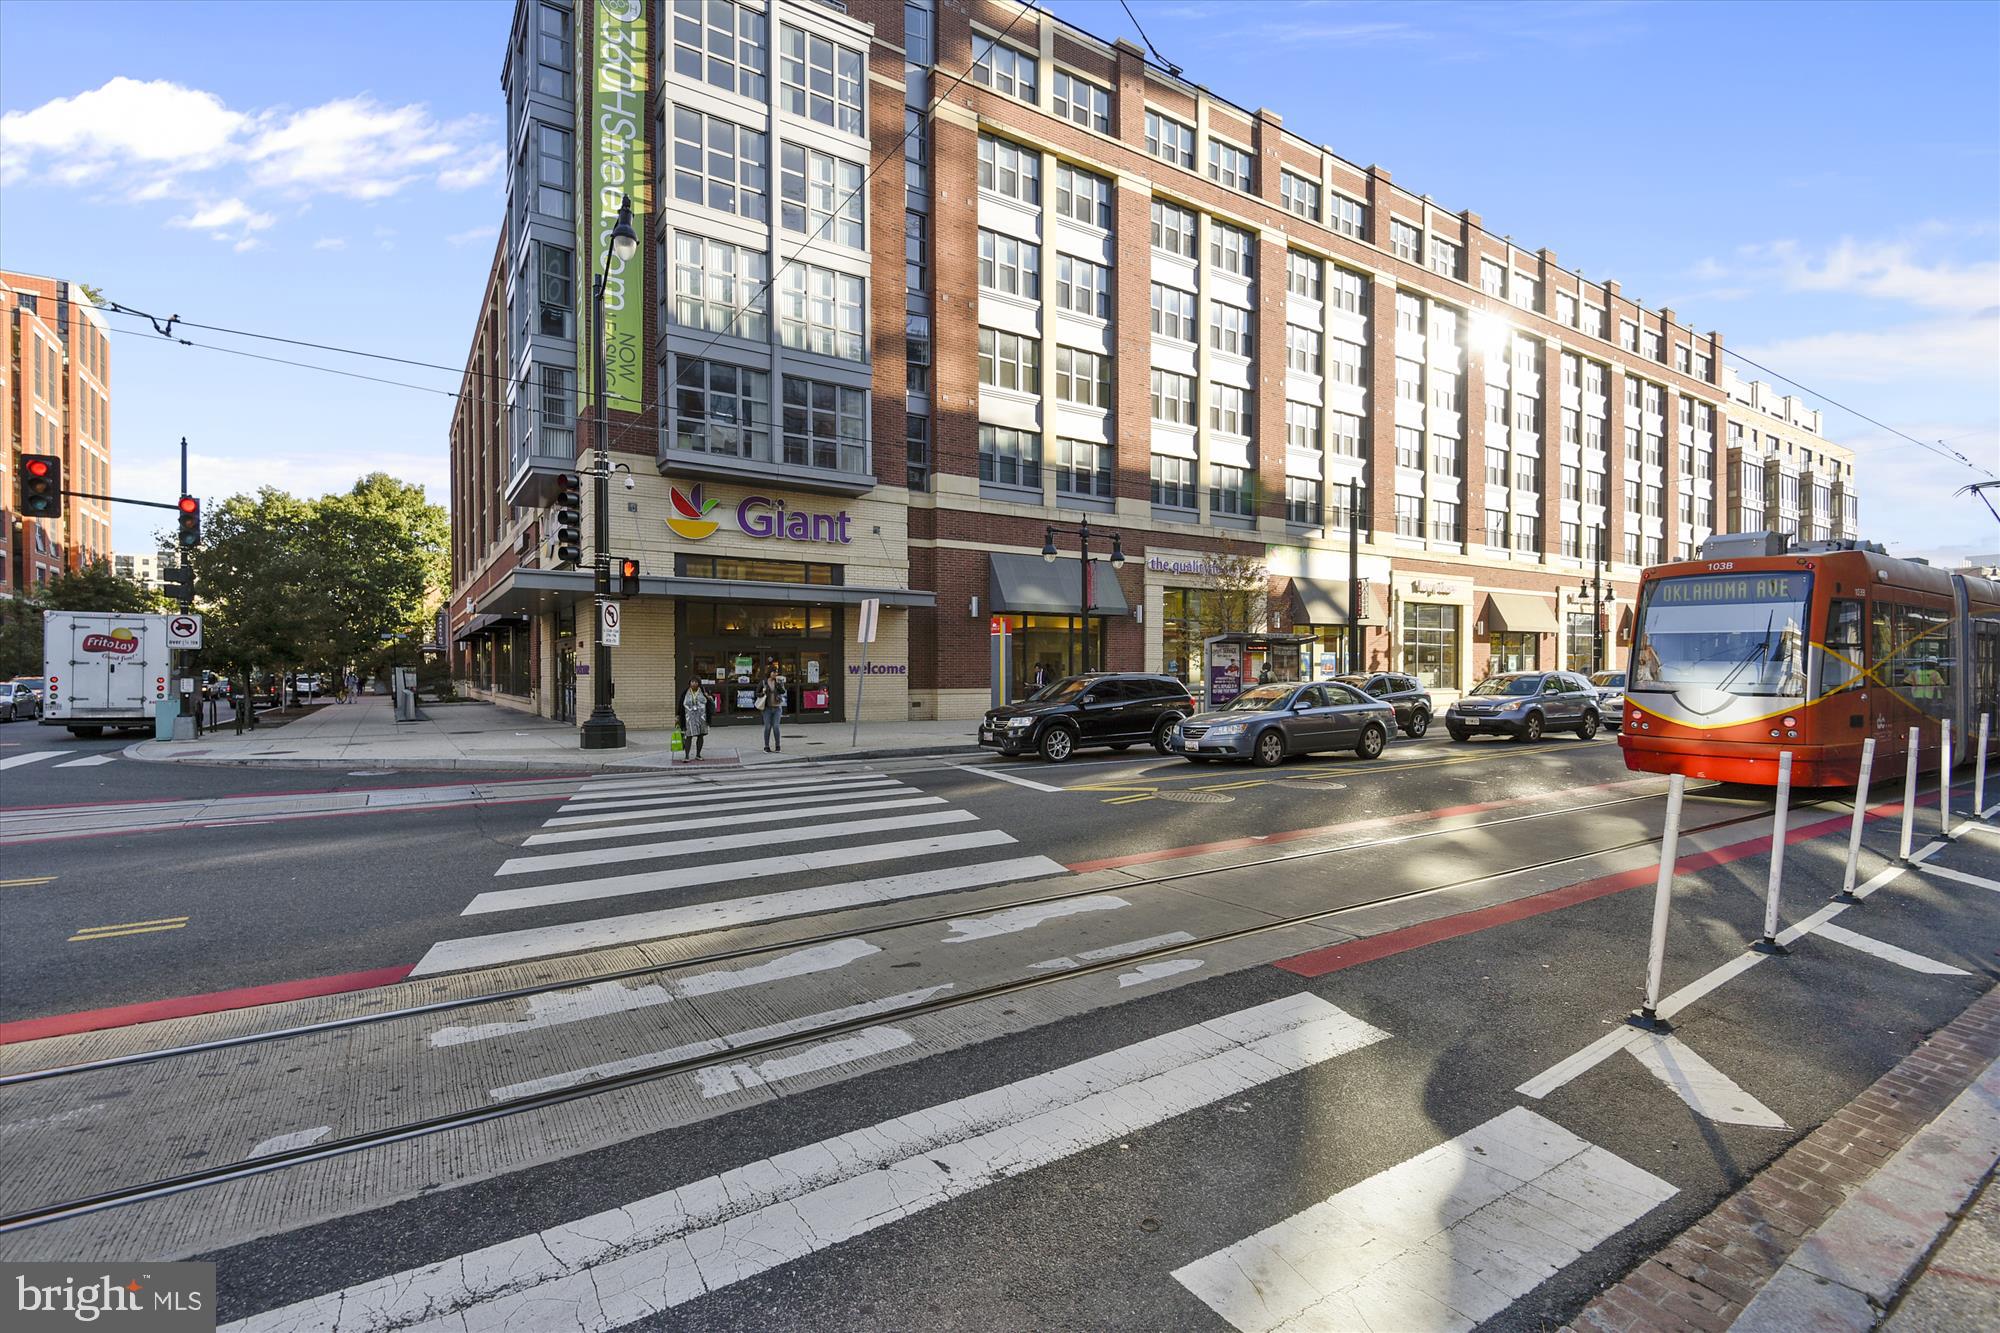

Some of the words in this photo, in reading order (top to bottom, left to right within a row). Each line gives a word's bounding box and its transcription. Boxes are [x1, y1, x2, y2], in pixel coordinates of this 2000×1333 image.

[618, 332, 636, 383] NOW
[736, 495, 852, 545] Giant
[1150, 557, 1169, 571] the
[1707, 562, 1734, 571] 103B
[1663, 580, 1747, 602] OKLAHOMA
[1756, 578, 1790, 598] AVE
[849, 661, 906, 675] welcome
